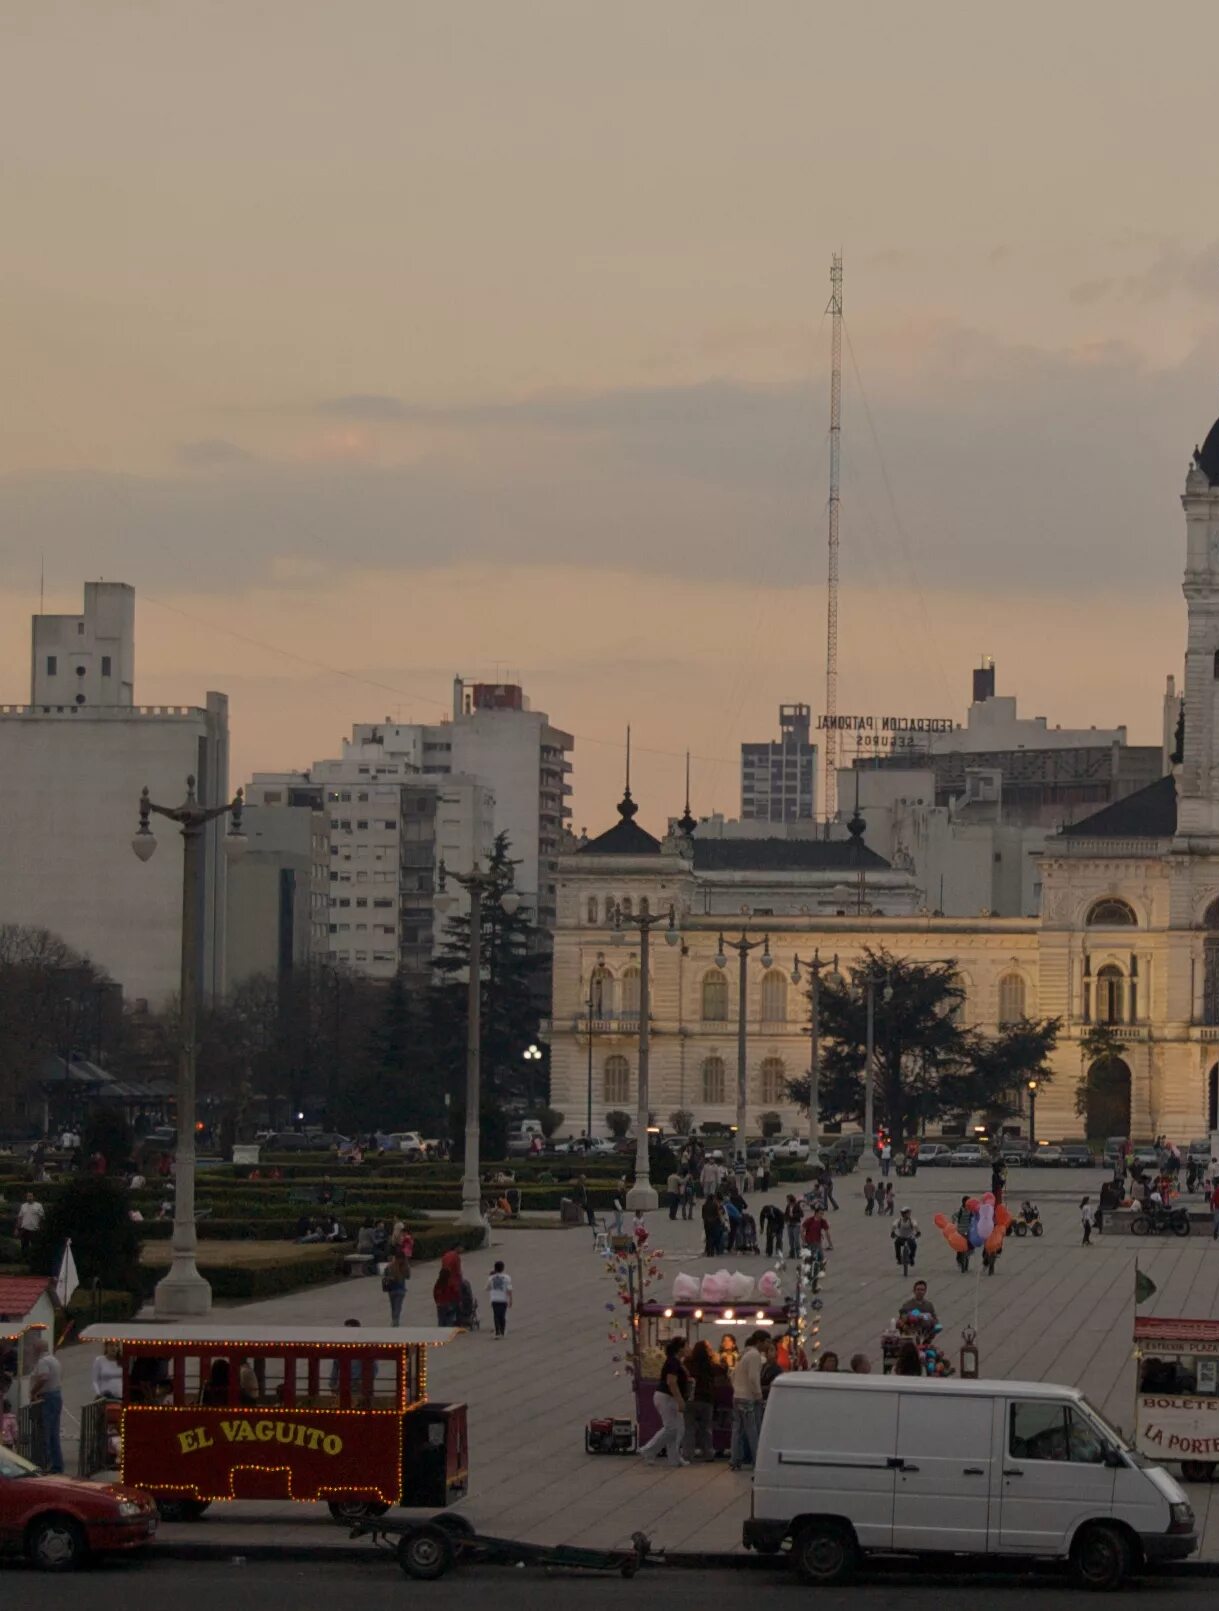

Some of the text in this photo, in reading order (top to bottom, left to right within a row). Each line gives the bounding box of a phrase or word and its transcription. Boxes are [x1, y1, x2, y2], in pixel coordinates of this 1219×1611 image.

[1190, 1343, 1218, 1353] PLAZA
[176, 1419, 343, 1456] EL VAGUITO
[1144, 1424, 1163, 1445] LA
